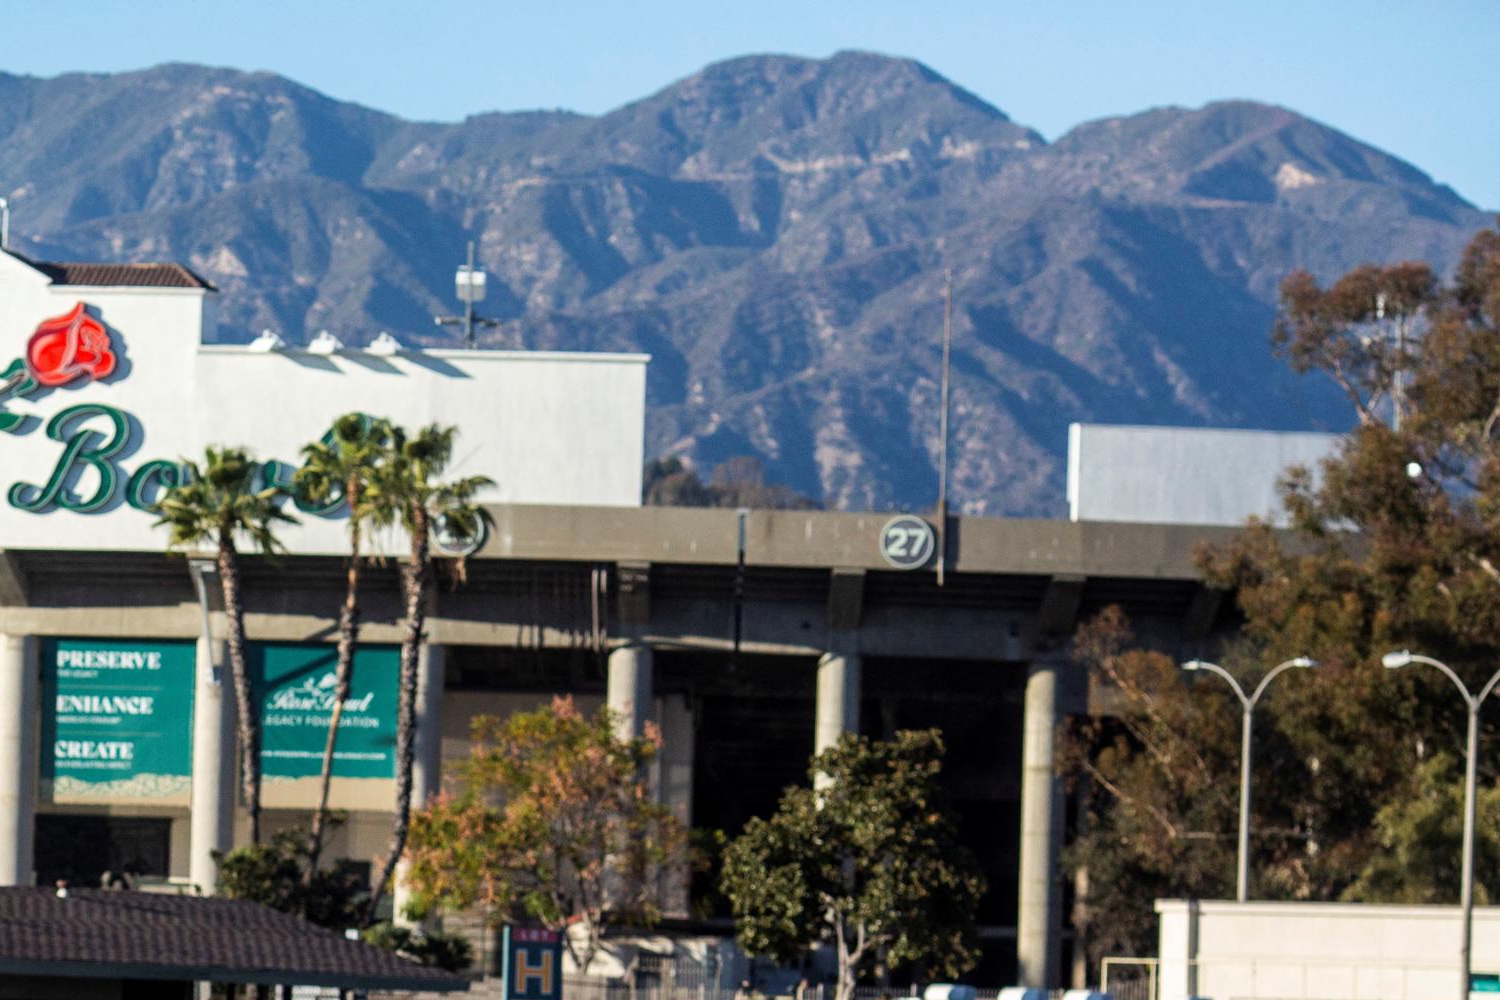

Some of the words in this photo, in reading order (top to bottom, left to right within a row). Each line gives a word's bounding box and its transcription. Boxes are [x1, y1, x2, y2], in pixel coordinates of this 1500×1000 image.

[887, 528, 926, 557] 27
[56, 649, 161, 670] PRESERVE
[56, 694, 154, 715] ENHANCE
[304, 715, 380, 729] FOUDATION
[54, 740, 134, 759] CREATE
[515, 948, 554, 989] H
